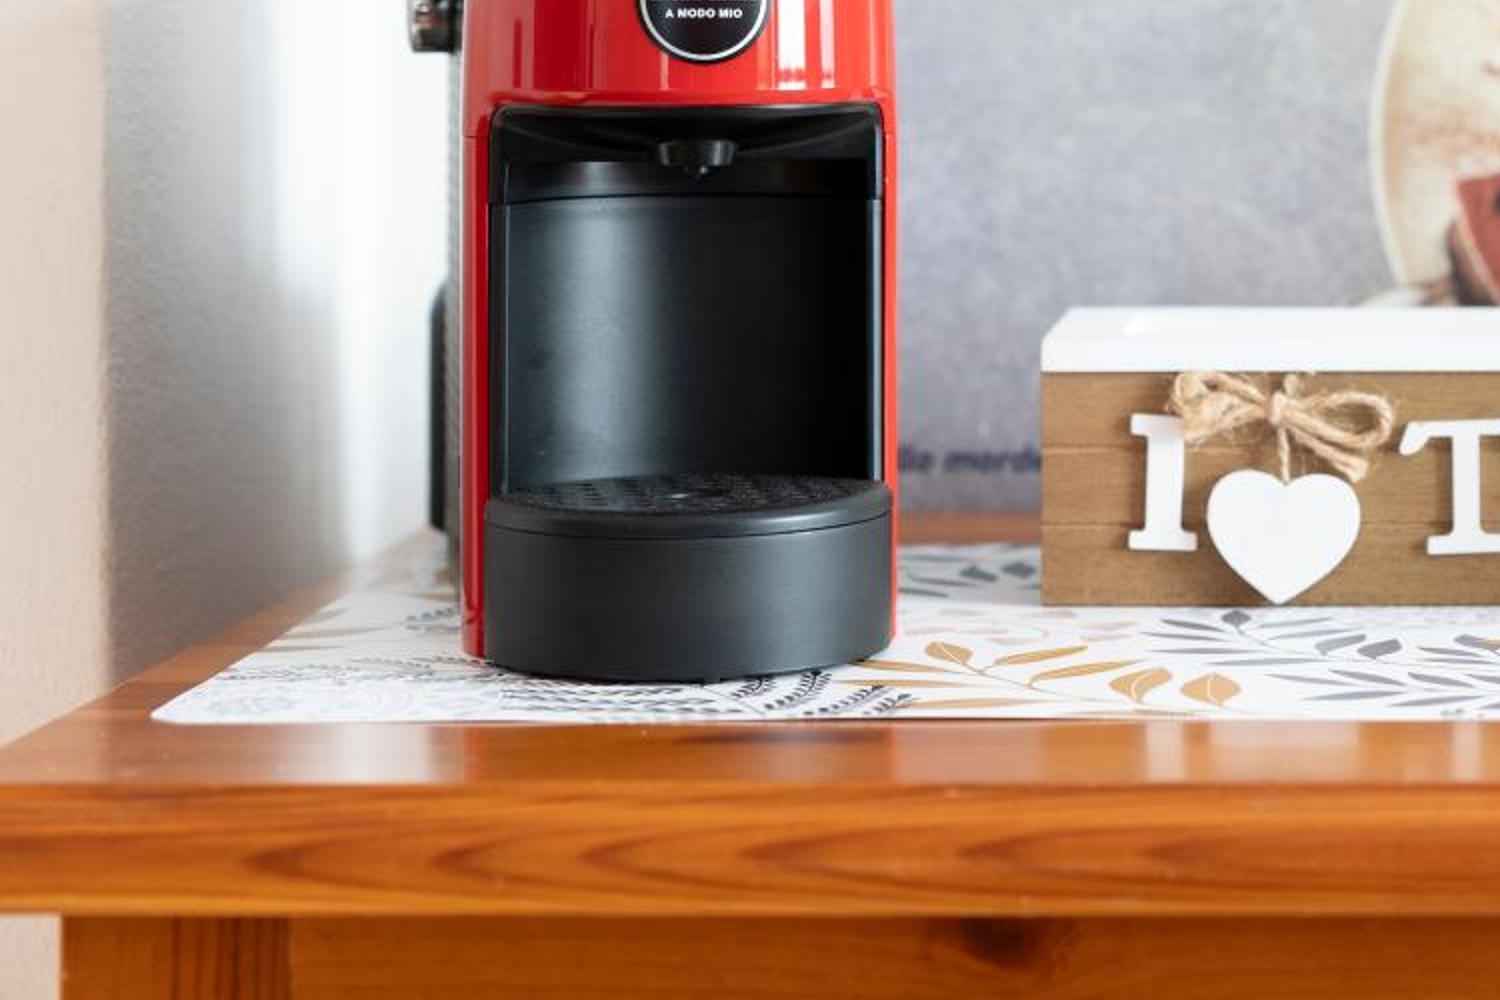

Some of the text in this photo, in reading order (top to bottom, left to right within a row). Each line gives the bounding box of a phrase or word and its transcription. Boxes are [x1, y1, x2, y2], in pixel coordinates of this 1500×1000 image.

[665, 8, 743, 19] A MODO MIO
[1127, 413, 1197, 552] I
